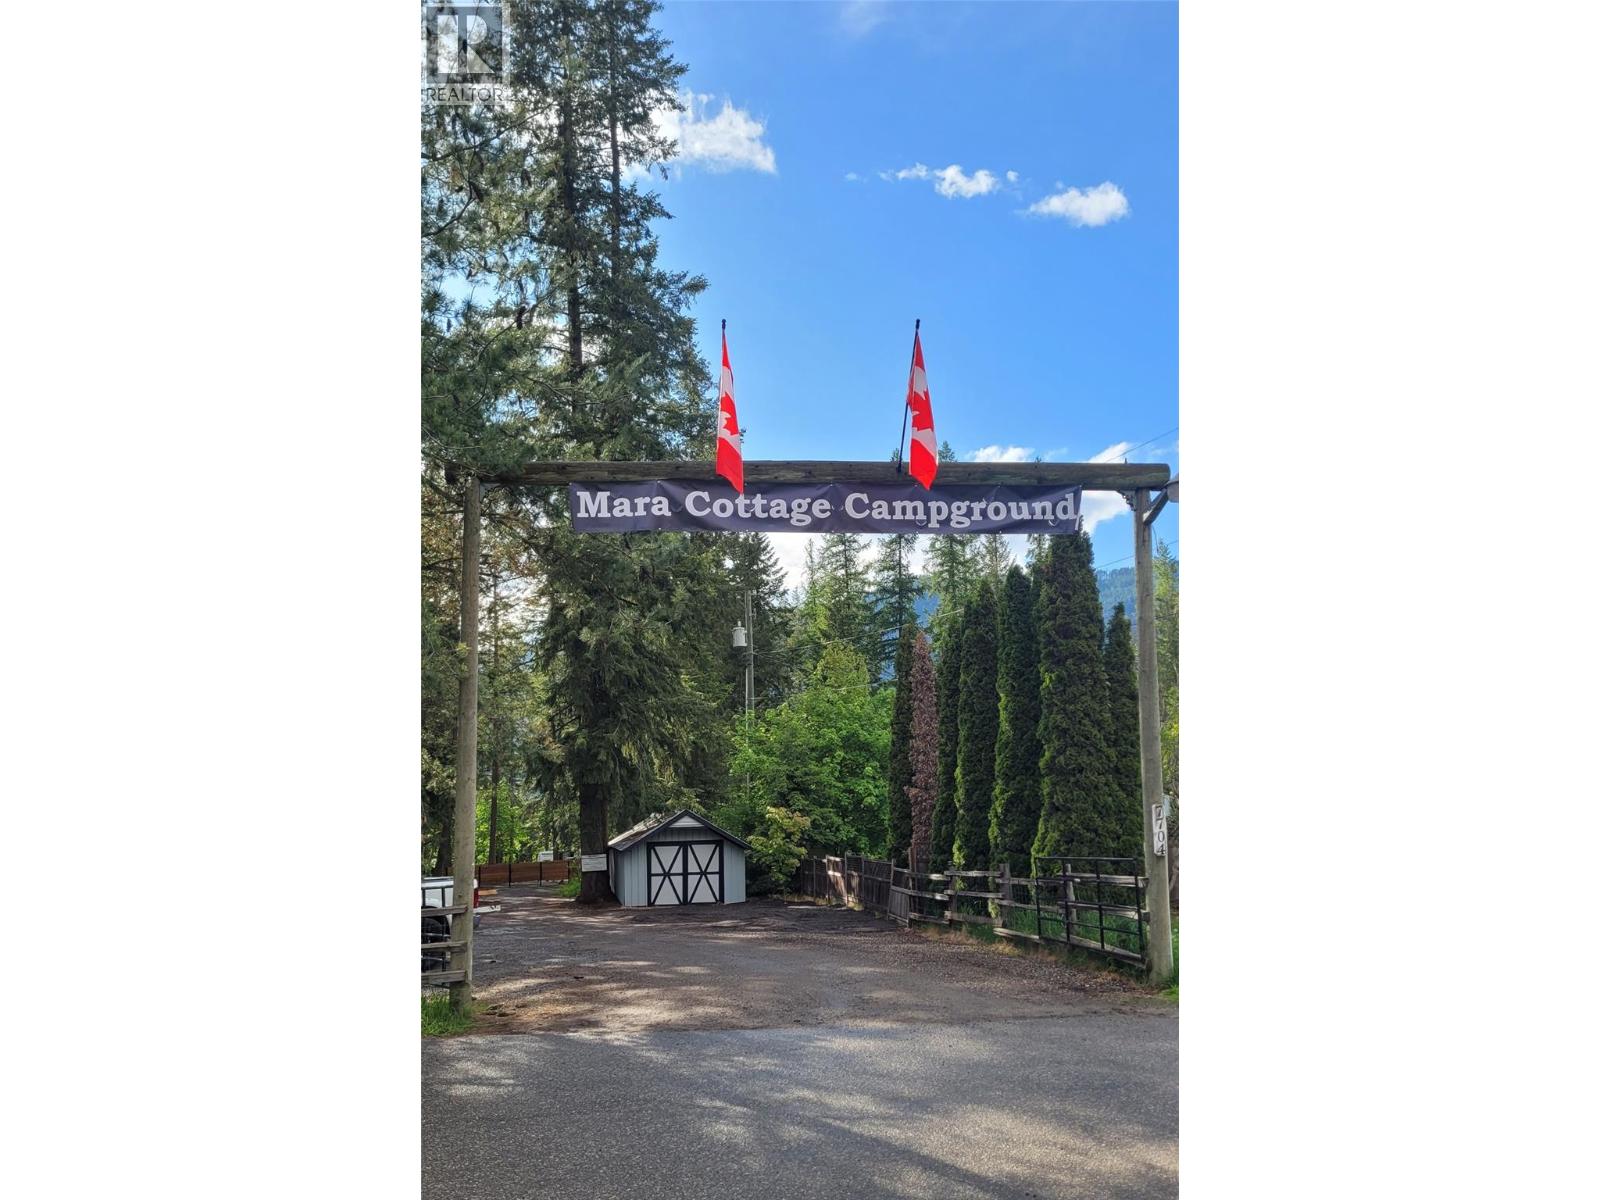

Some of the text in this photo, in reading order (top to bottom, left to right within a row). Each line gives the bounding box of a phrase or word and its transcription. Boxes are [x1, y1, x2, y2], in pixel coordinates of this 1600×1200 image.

[576, 490, 1077, 528] Mara Cottage Campground
